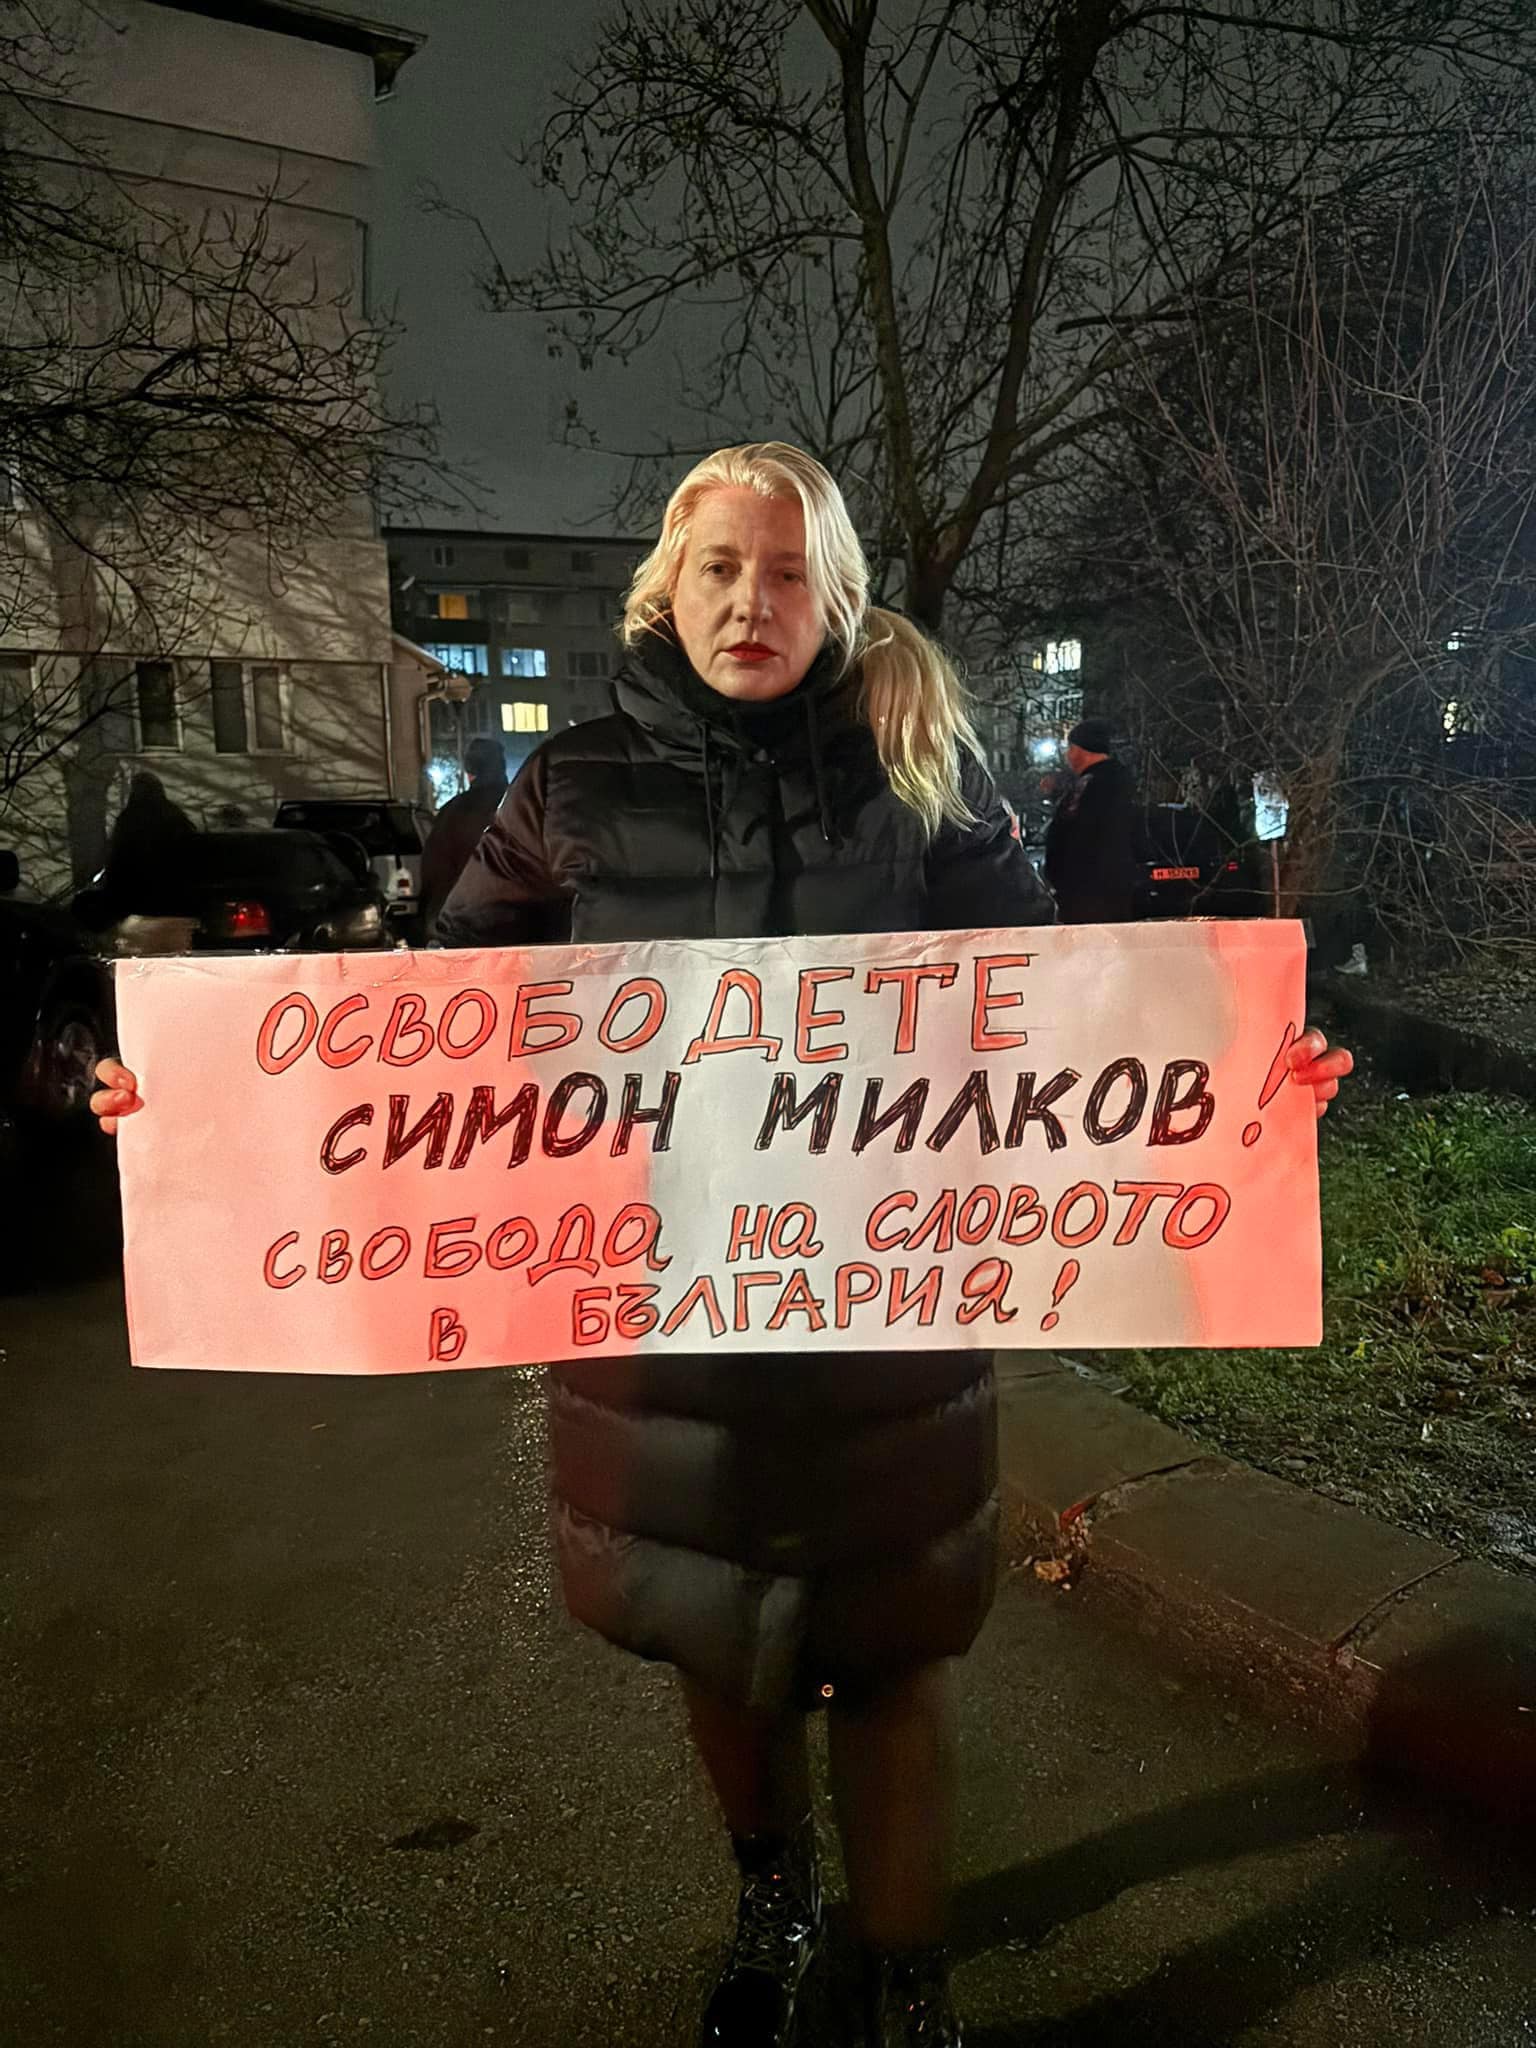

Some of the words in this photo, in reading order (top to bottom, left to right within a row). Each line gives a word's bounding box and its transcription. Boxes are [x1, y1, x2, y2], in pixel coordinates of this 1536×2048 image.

[256, 953, 1038, 1075] ОСВОБОДЕТЕ
[320, 1071, 682, 1175] СИМОН
[866, 1180, 1231, 1252] СЛОВОТО
